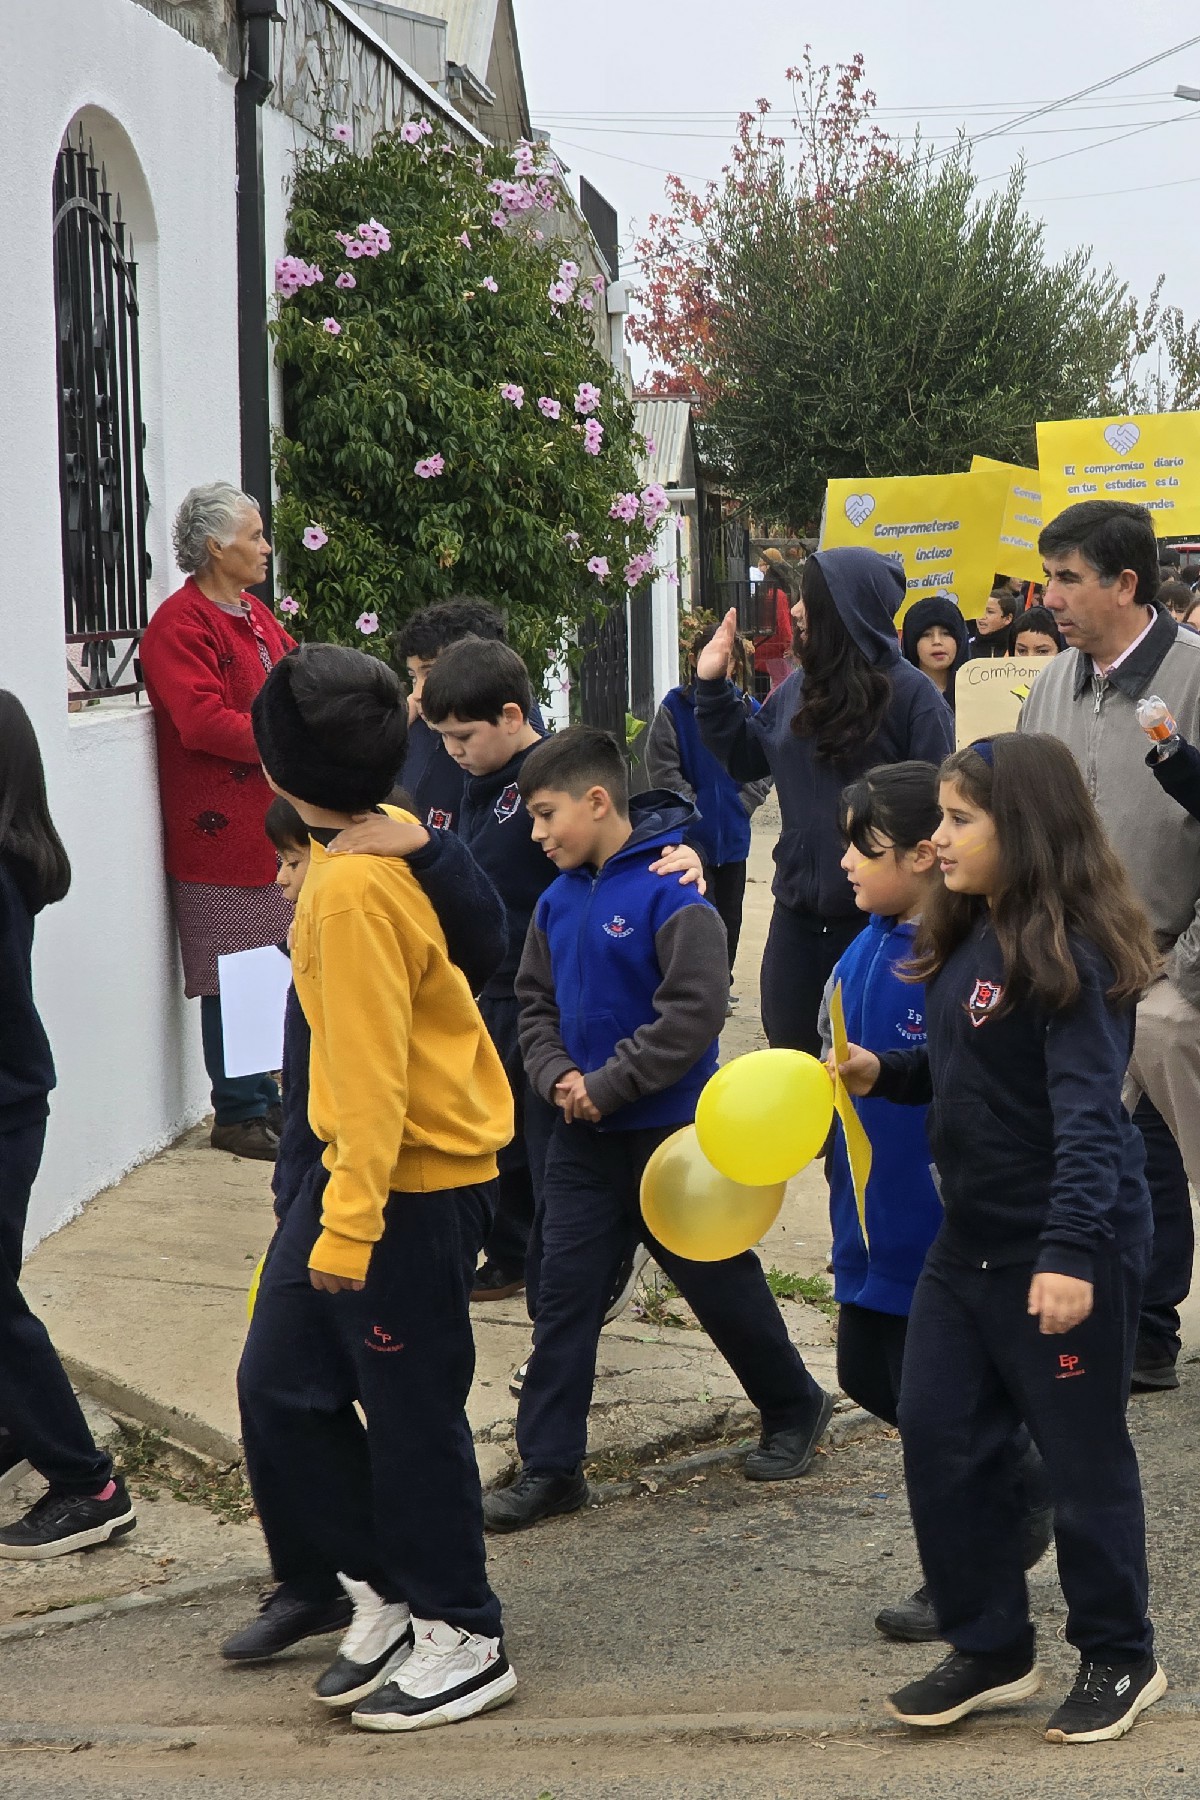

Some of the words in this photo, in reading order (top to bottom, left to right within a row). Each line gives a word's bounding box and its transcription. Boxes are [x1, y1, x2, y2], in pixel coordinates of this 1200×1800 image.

[1065, 465, 1076, 476] El
[1084, 461, 1145, 475] compromiso
[1154, 457, 1184, 467] diario
[1068, 485, 1079, 494] en
[1082, 483, 1098, 494] tus
[1105, 478, 1147, 490] estudios
[1155, 478, 1166, 486] es
[1168, 476, 1179, 486] la
[874, 519, 960, 538] Comprometerse
[915, 547, 953, 561] incluso
[907, 578, 920, 588] es
[907, 1008, 923, 1025] EP
[373, 1325, 392, 1344] EP
[1058, 1354, 1079, 1370] EP
